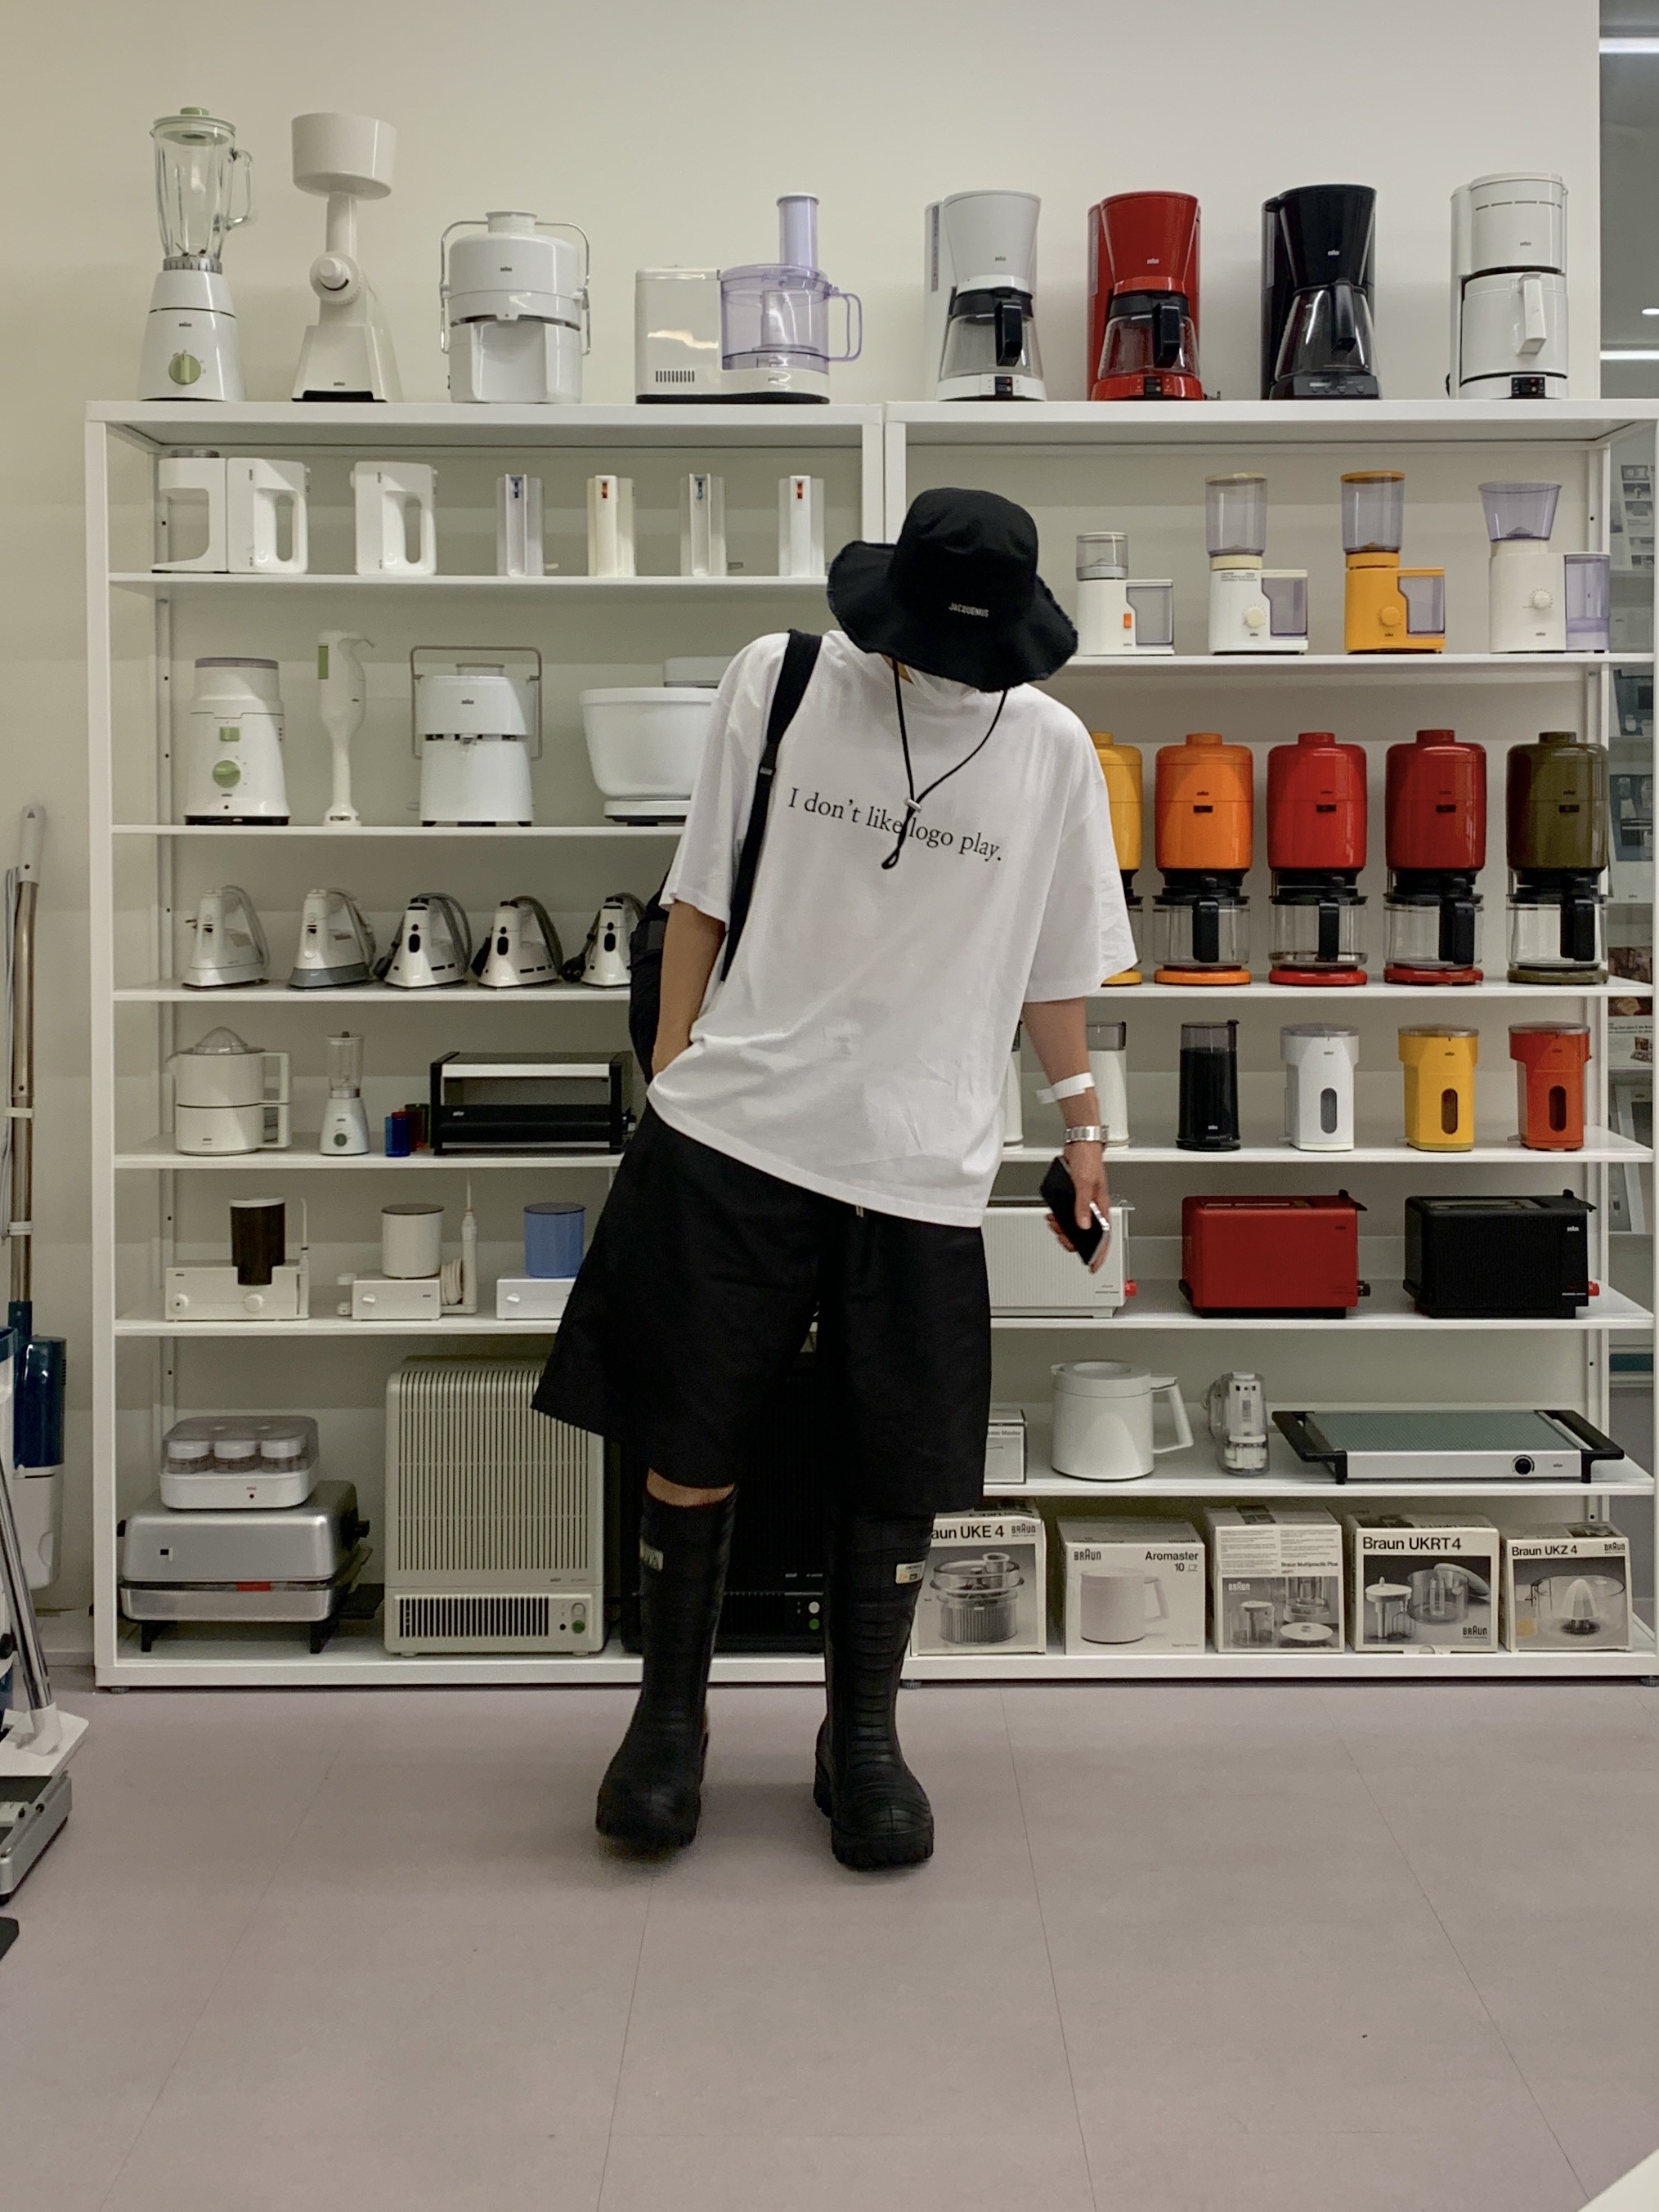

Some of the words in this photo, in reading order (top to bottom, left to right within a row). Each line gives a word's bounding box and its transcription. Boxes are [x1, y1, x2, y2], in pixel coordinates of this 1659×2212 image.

[788, 787, 799, 808] I
[866, 806, 903, 834] like
[908, 817, 953, 849] logo
[958, 832, 1002, 862] play.
[930, 1529, 957, 1539] aun
[960, 1525, 992, 1538] UKE
[995, 1525, 1004, 1538] 4
[1011, 1524, 1036, 1534] BRAUN
[1363, 1537, 1404, 1550] Braun
[1604, 1542, 1625, 1552] BRAUN
[1074, 1548, 1101, 1560] BRAUN
[1145, 1551, 1199, 1560] Aromaster
[1513, 1547, 1541, 1556] Braun
[1545, 1546, 1568, 1555] UKZ
[1571, 1545, 1578, 1554] 4
[1174, 1563, 1185, 1571] 10
[1463, 1626, 1486, 1636] BRAUN
